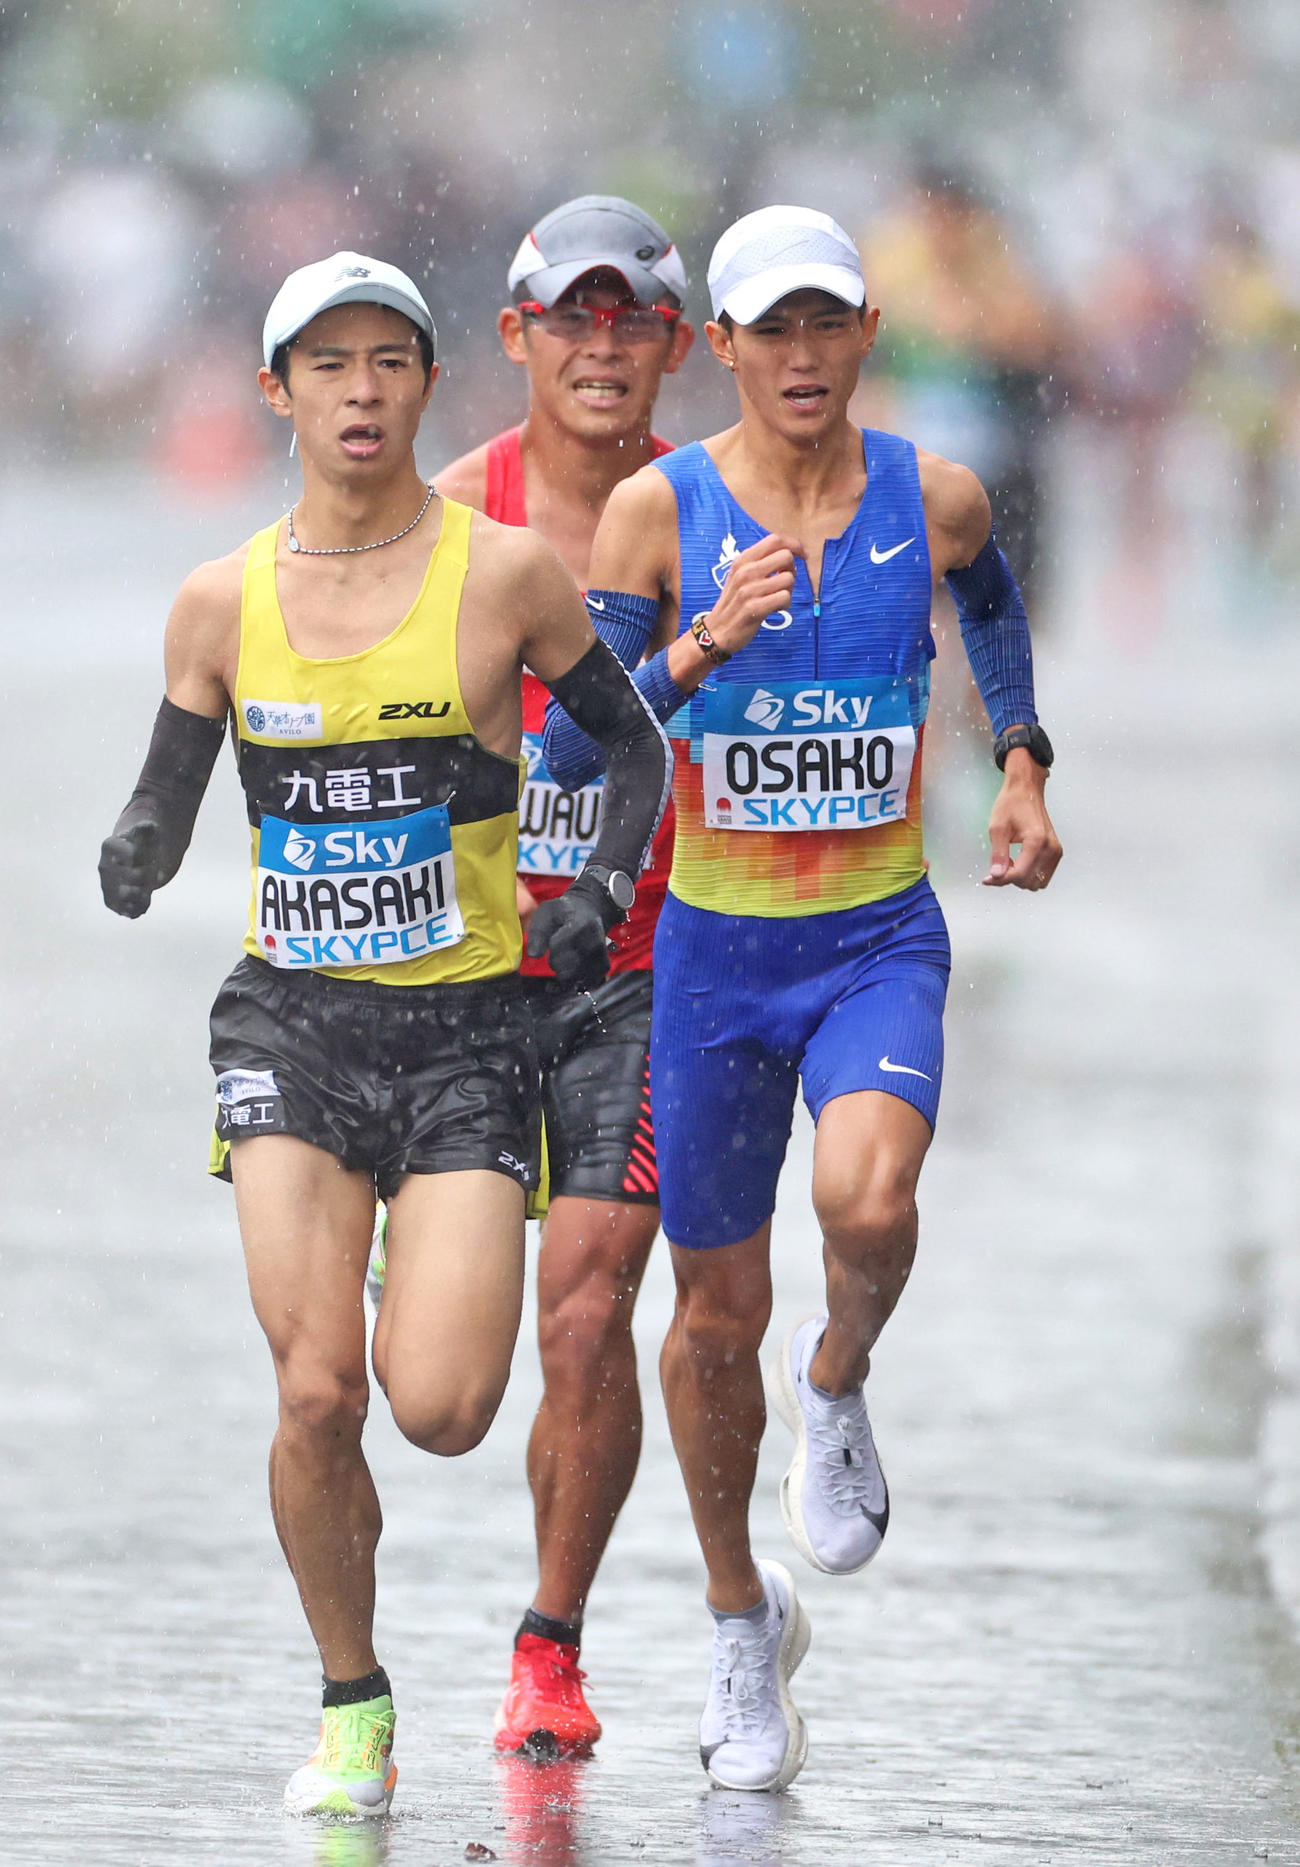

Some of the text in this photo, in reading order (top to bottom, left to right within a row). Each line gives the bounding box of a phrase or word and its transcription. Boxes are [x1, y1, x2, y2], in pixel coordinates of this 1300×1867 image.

[378, 701, 451, 720] 2XU
[792, 689, 873, 728] Sky
[725, 735, 894, 795] OSAKO
[282, 765, 421, 813] 九電工
[743, 789, 899, 826] SKYPCE
[518, 788, 600, 841] WAU
[324, 831, 409, 867] Sky
[518, 842, 596, 870] KYP
[261, 861, 445, 931] AKASAKI
[285, 913, 453, 964] SKYPCE
